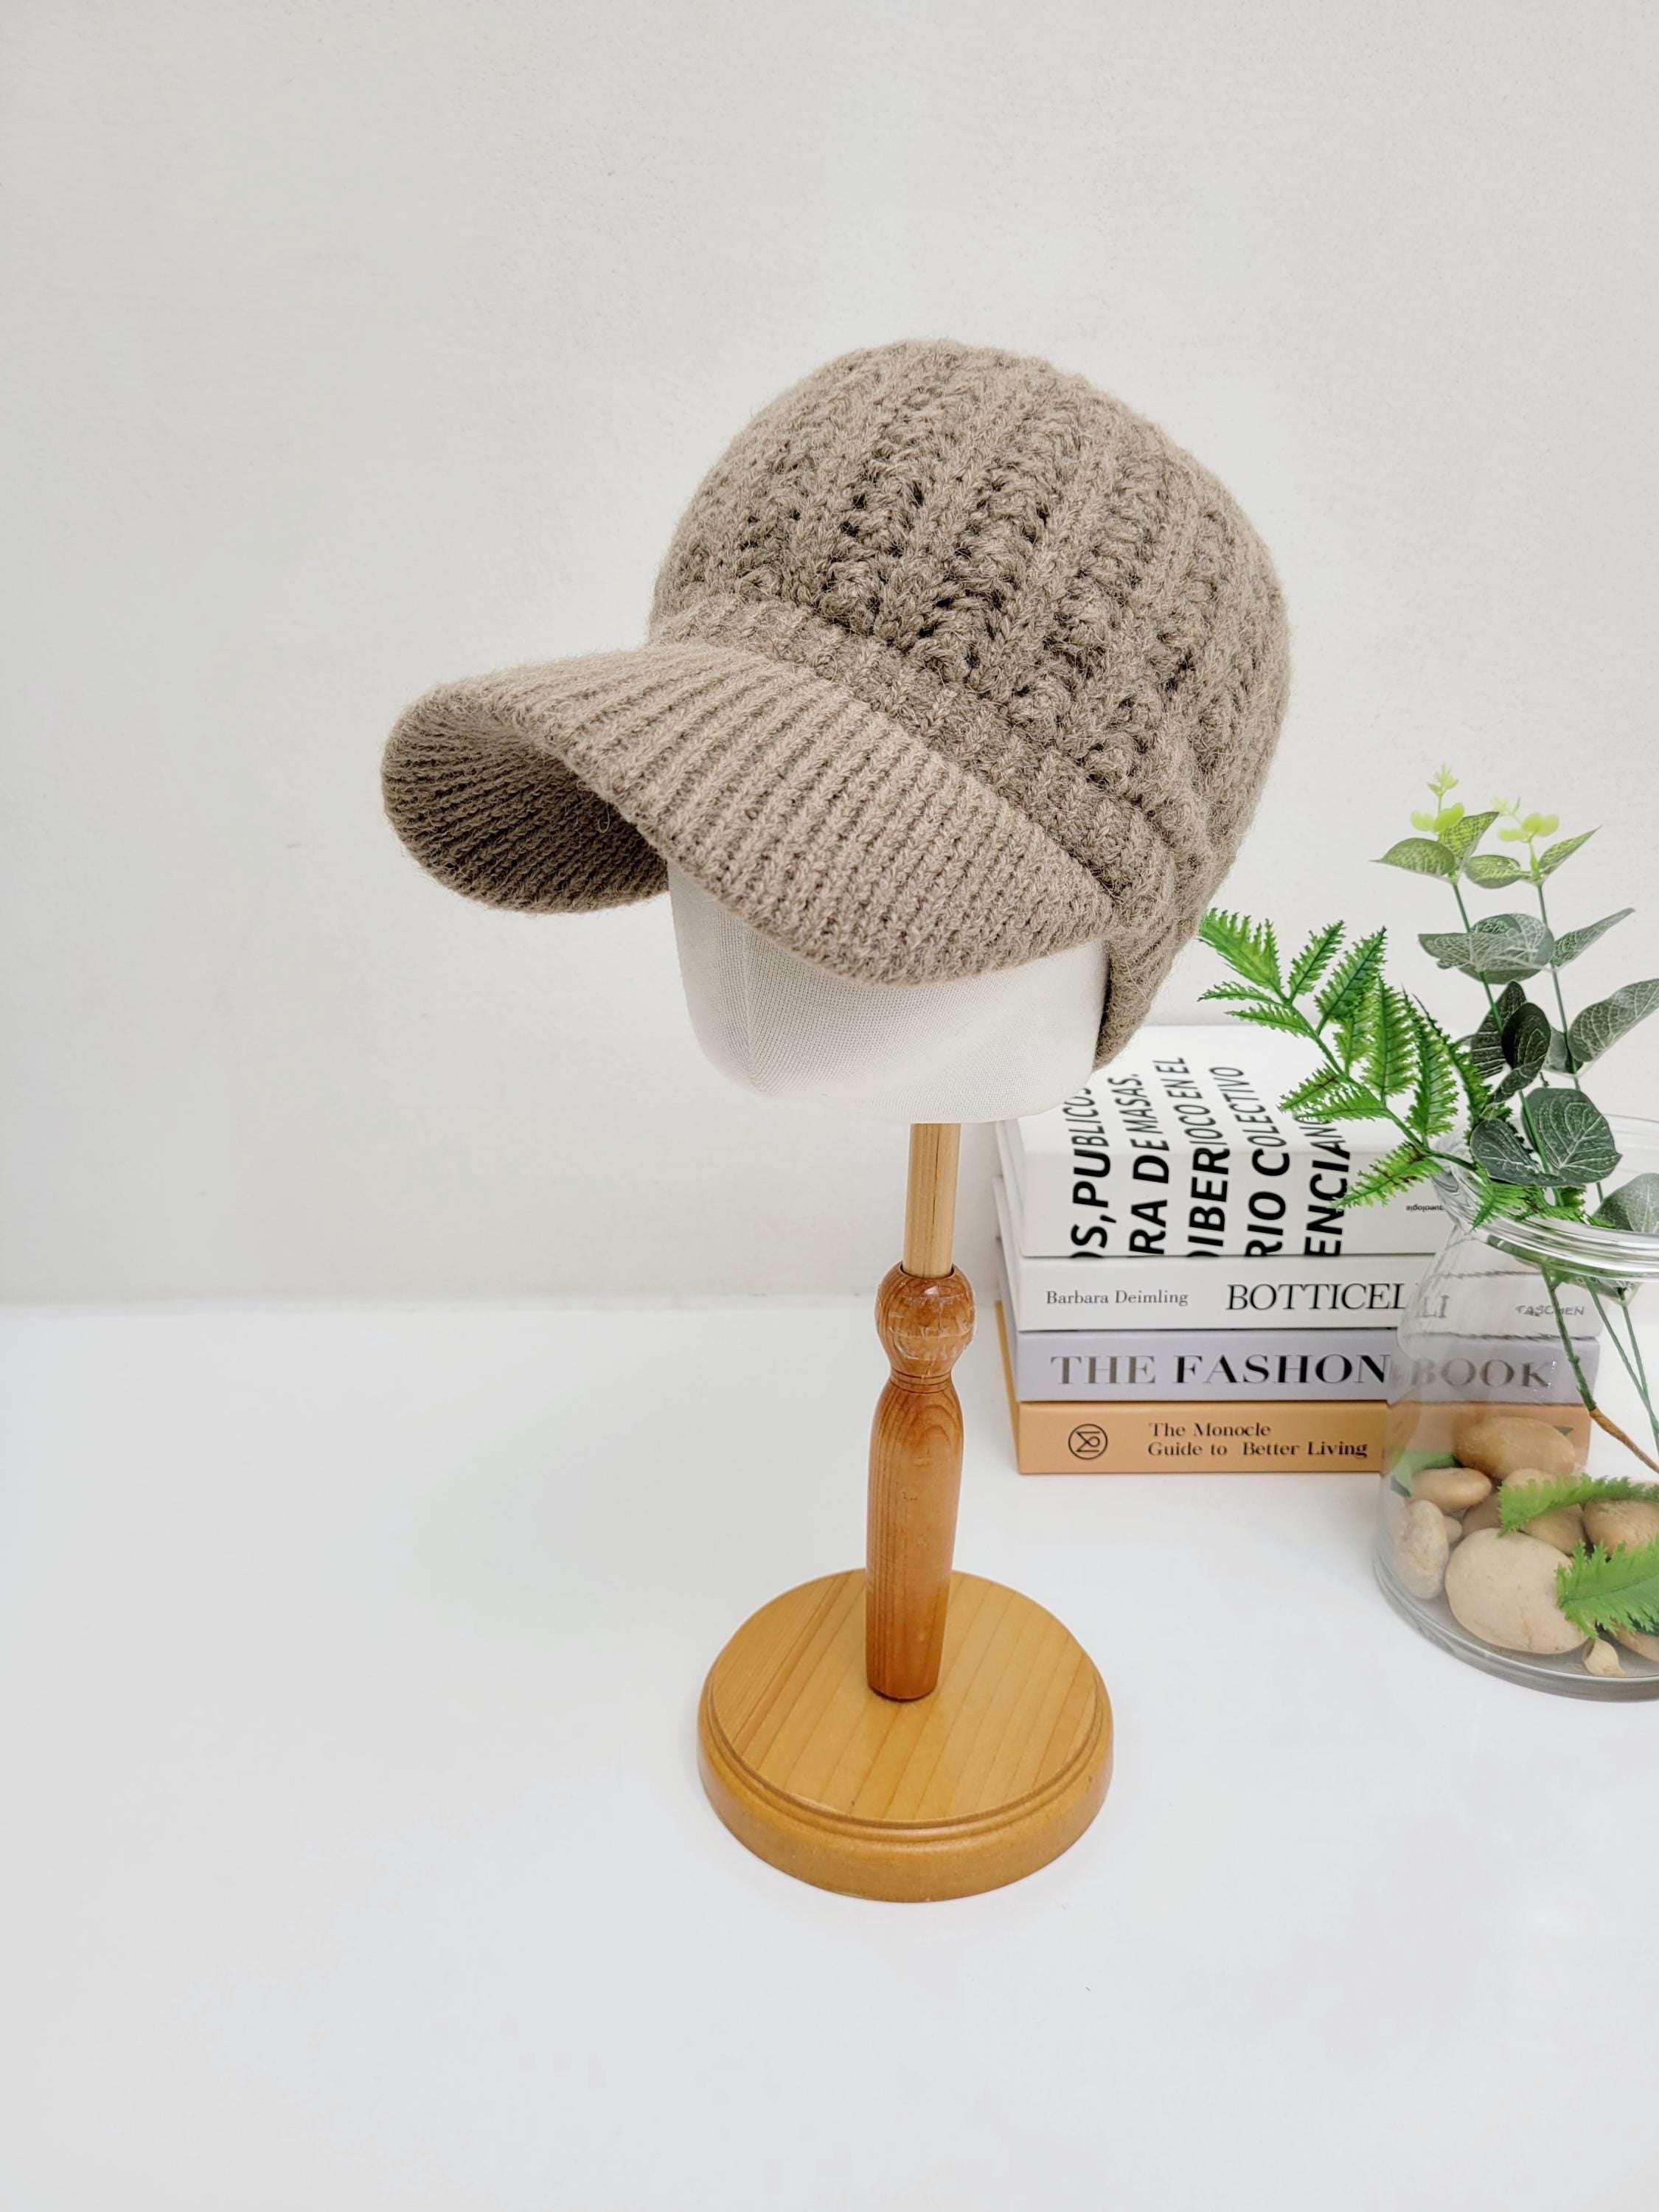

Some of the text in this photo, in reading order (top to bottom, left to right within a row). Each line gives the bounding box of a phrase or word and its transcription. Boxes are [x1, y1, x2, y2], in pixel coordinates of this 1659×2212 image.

[1208, 1067, 1290, 1177] COLECTIVO
[1107, 1074, 1171, 1256] RA DE MASAS.
[1152, 1057, 1231, 1258] IBERIOCO EN EL
[1046, 1288, 1189, 1307] Barbara Deimling
[1050, 1355, 1155, 1384] THE
[1172, 1354, 1391, 1384] FASHON
[1148, 1422, 1272, 1437] The Monocle
[1148, 1440, 1368, 1458] Guide to Better Living
